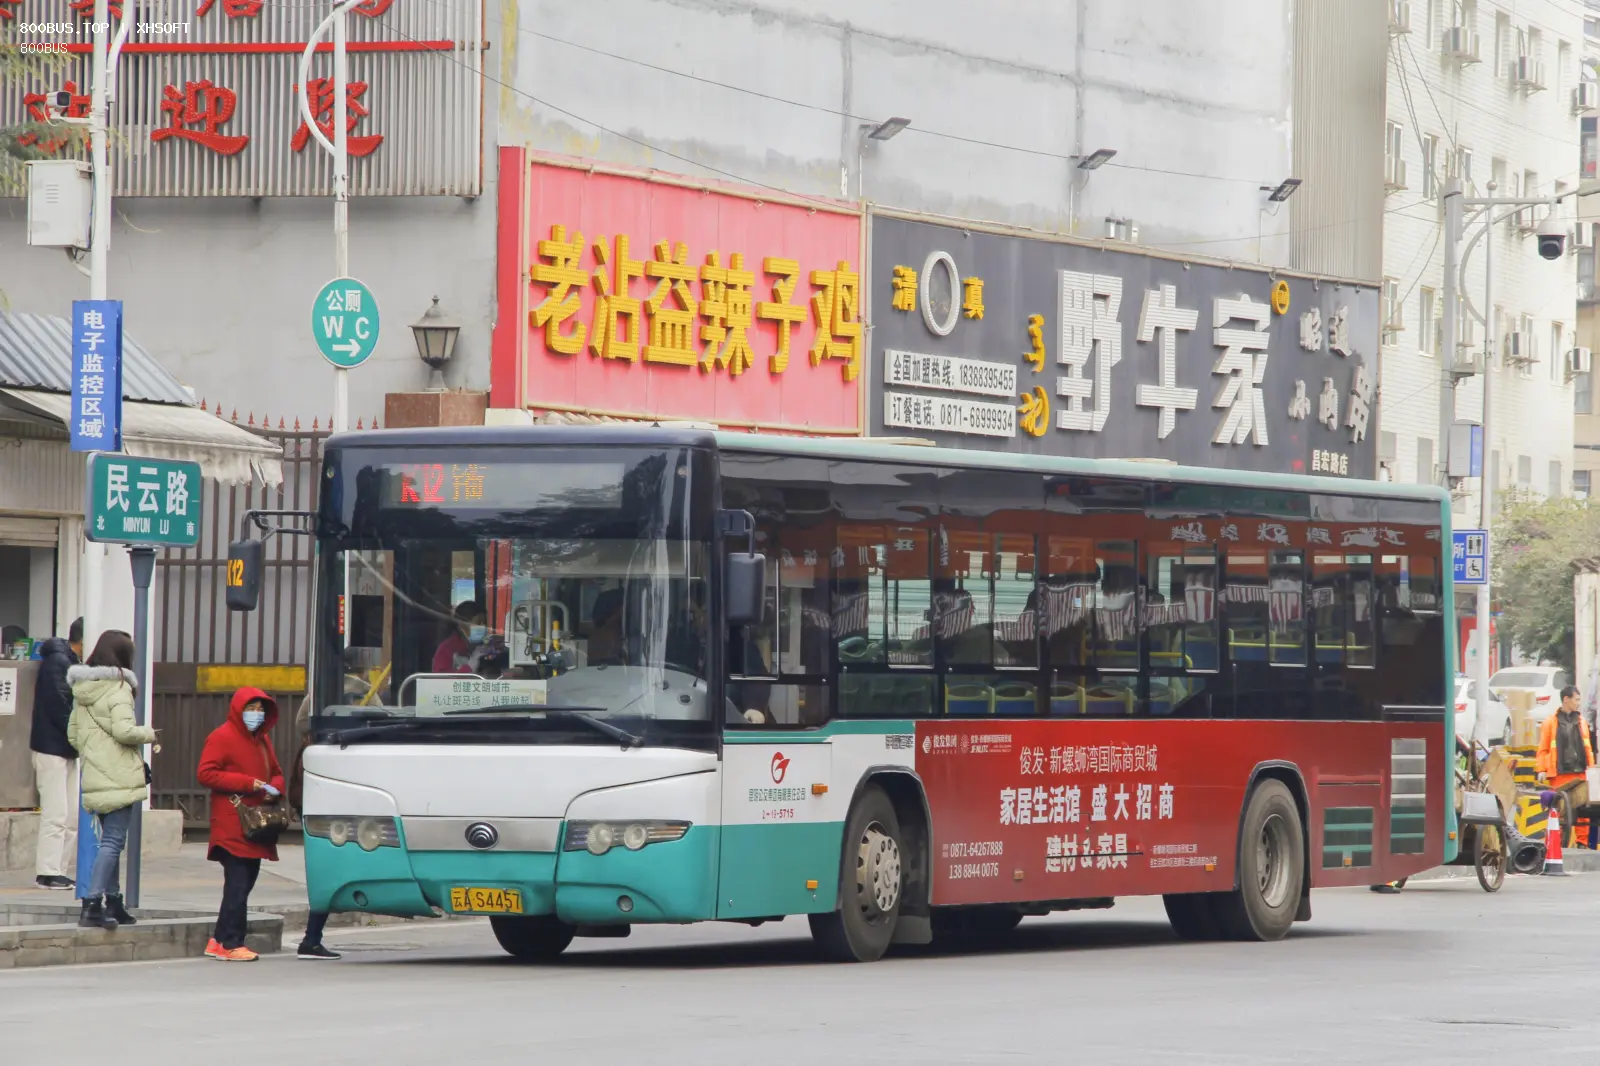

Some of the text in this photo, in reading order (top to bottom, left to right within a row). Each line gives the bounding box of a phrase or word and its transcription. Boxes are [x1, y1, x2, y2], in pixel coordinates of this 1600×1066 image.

[326, 289, 362, 313] 公厕
[530, 223, 863, 382] 老沾益辣子鸡
[892, 265, 985, 320] 清 真
[78, 309, 106, 439] 电子监控区域
[1056, 270, 1271, 447] 野牛家
[106, 463, 189, 516] 民云路
[96, 515, 105, 531] 北
[159, 518, 170, 535] LU
[186, 521, 195, 536] 南
[452, 681, 511, 694] 创建文明城市
[1000, 782, 1174, 826] 家居生活馆 盛大招商
[949, 861, 1000, 879] 138 8844 0076
[950, 840, 1003, 858] 0871-64267888
